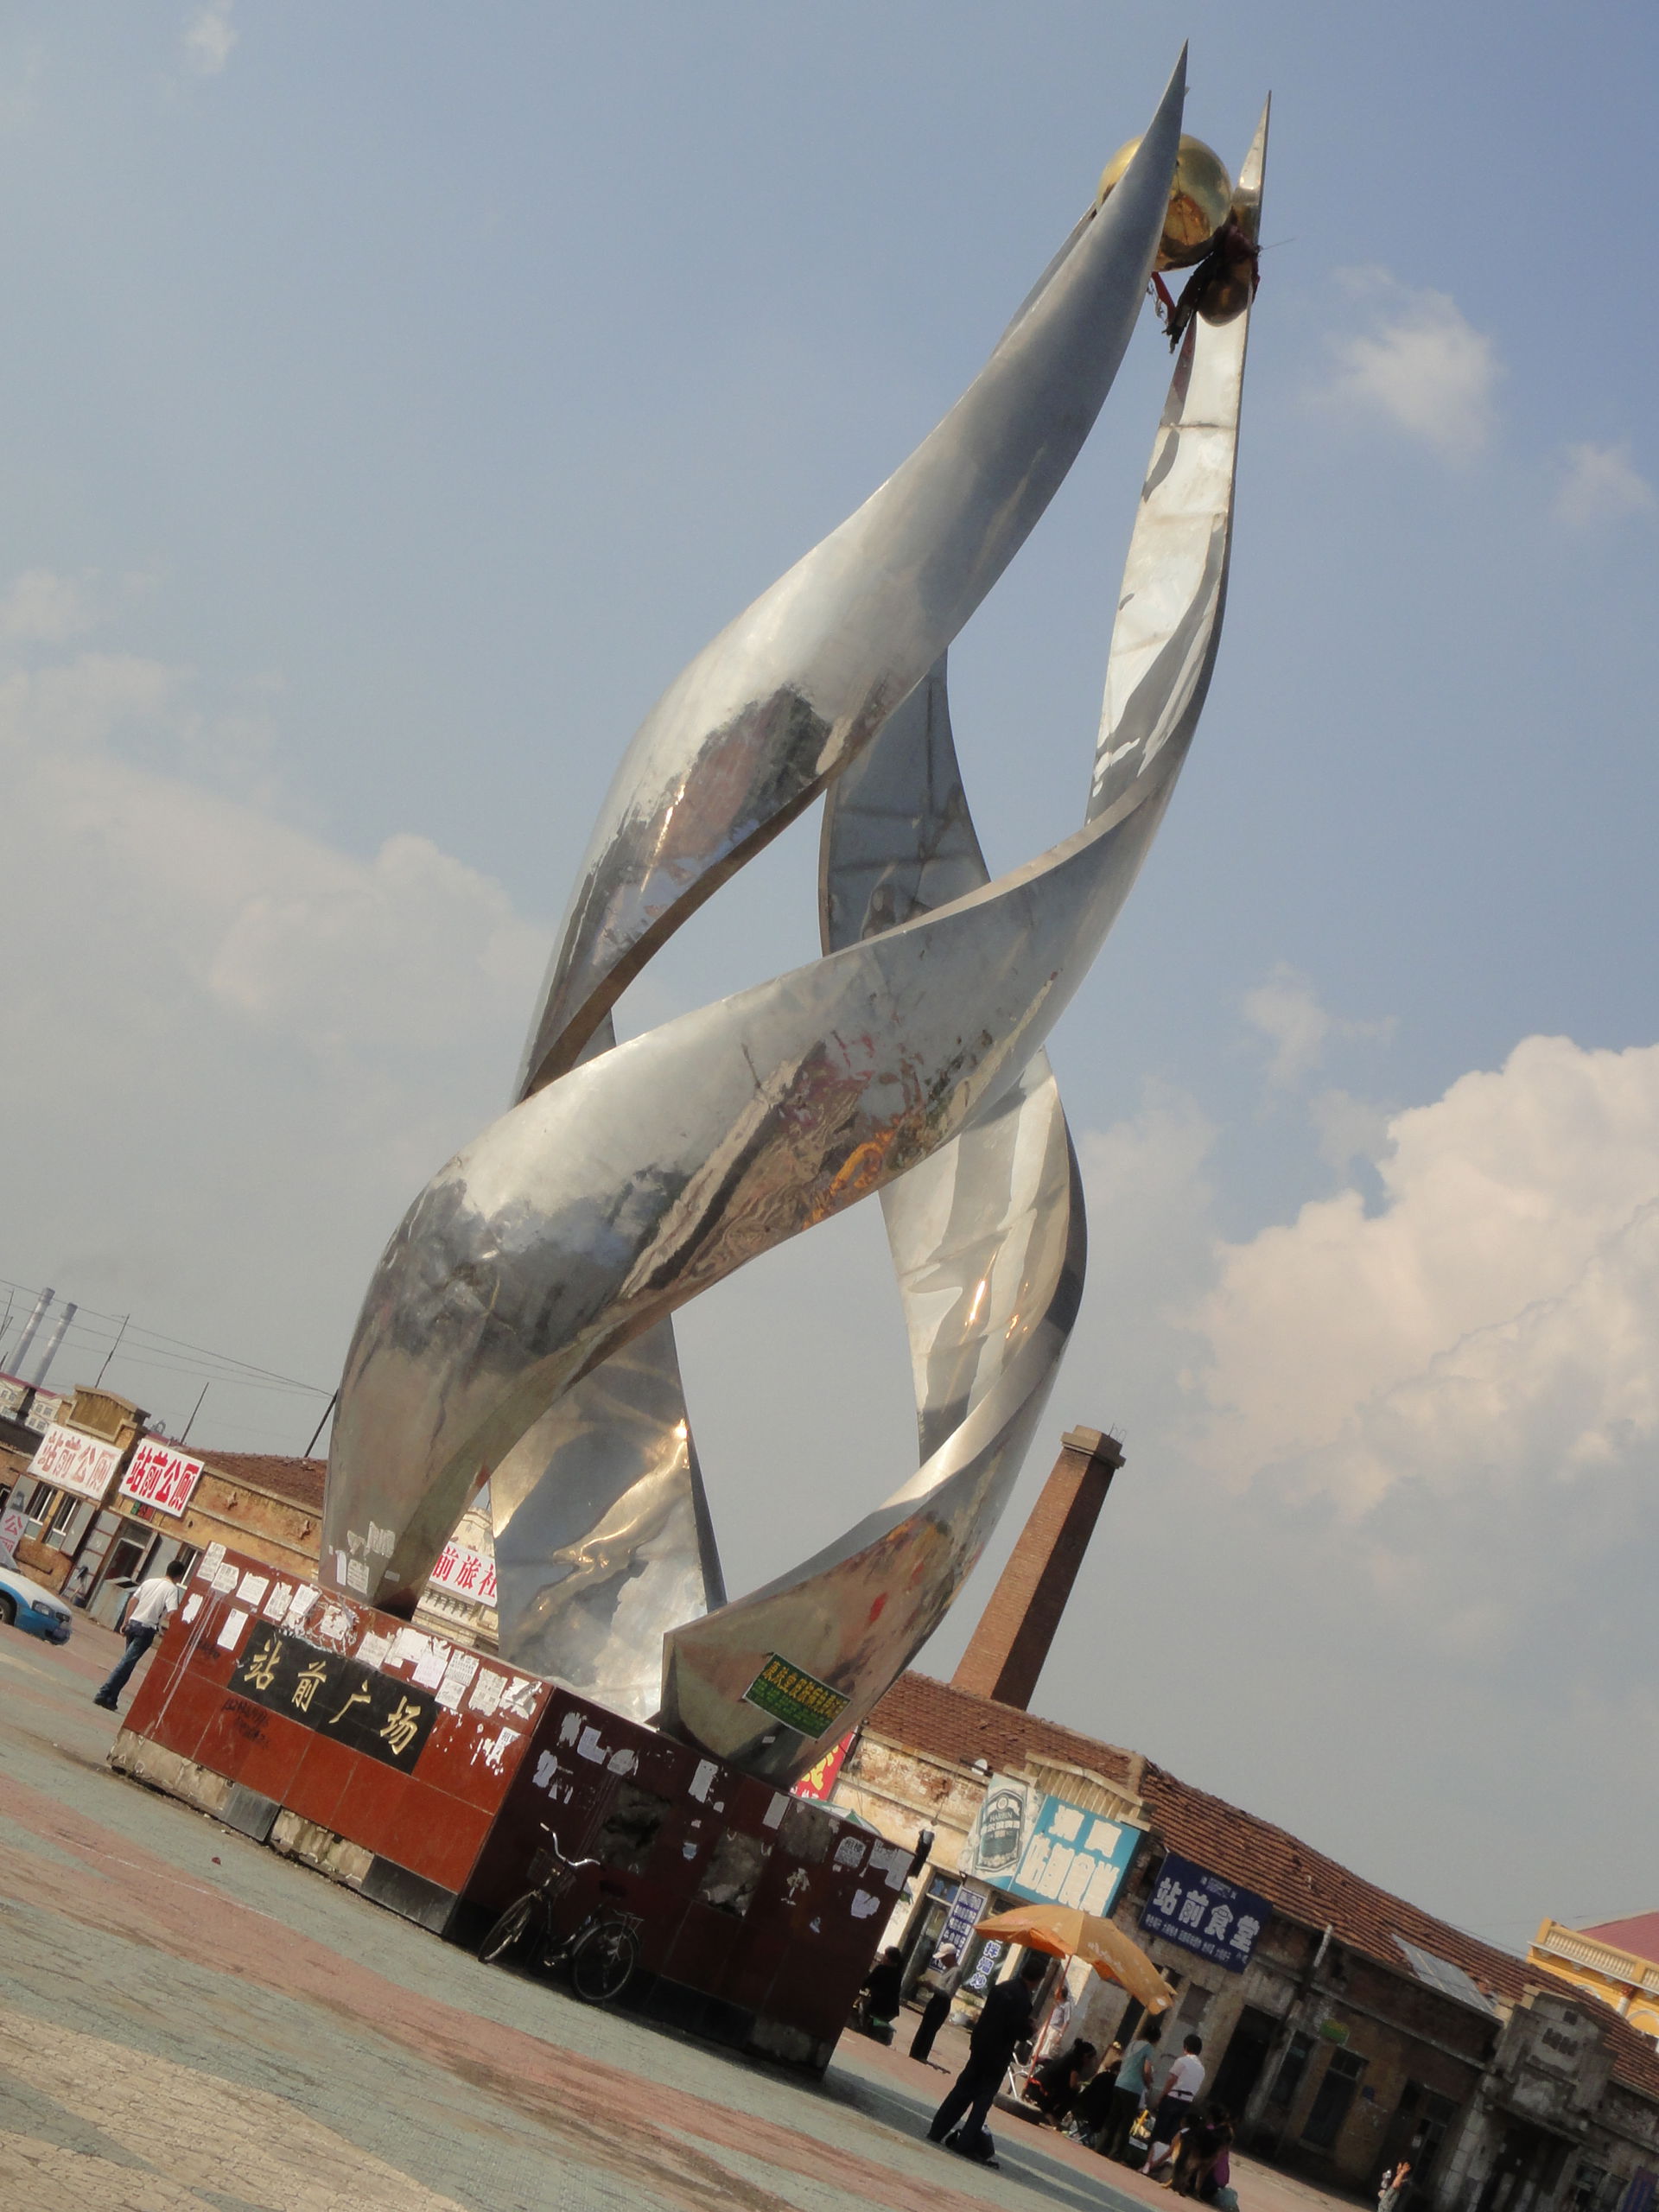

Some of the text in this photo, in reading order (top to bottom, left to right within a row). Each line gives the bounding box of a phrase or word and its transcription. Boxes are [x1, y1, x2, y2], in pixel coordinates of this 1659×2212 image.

[37, 1430, 116, 1493] 站前公厕
[126, 1446, 200, 1511] 站前公厕
[431, 1545, 498, 1599] 前旅社
[244, 1639, 422, 1755] 站前广场
[1153, 1877, 1261, 1954] 站前食堂
